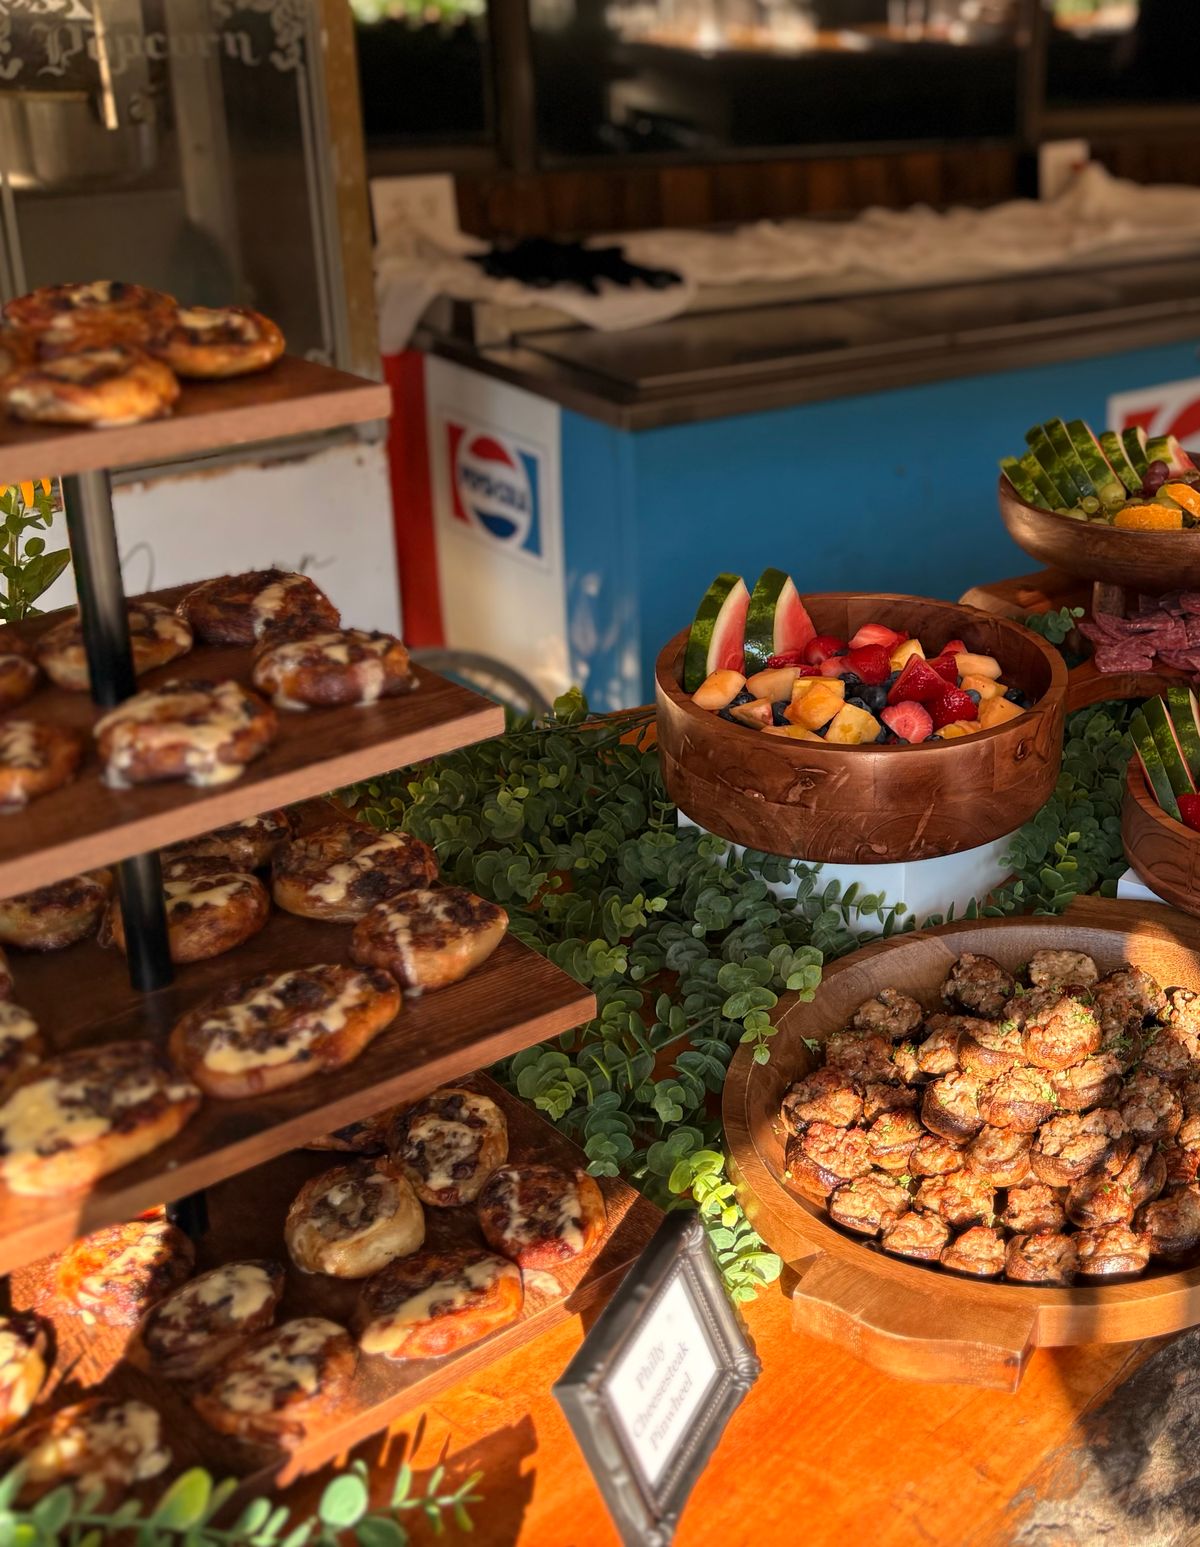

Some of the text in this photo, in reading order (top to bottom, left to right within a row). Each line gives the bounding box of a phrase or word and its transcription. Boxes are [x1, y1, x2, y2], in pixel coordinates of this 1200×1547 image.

[29, 21, 262, 77] Popcorn
[632, 1342, 689, 1438] Cheesesteak
[635, 1341, 665, 1391] Philly
[650, 1371, 693, 1450] Pinwheel
